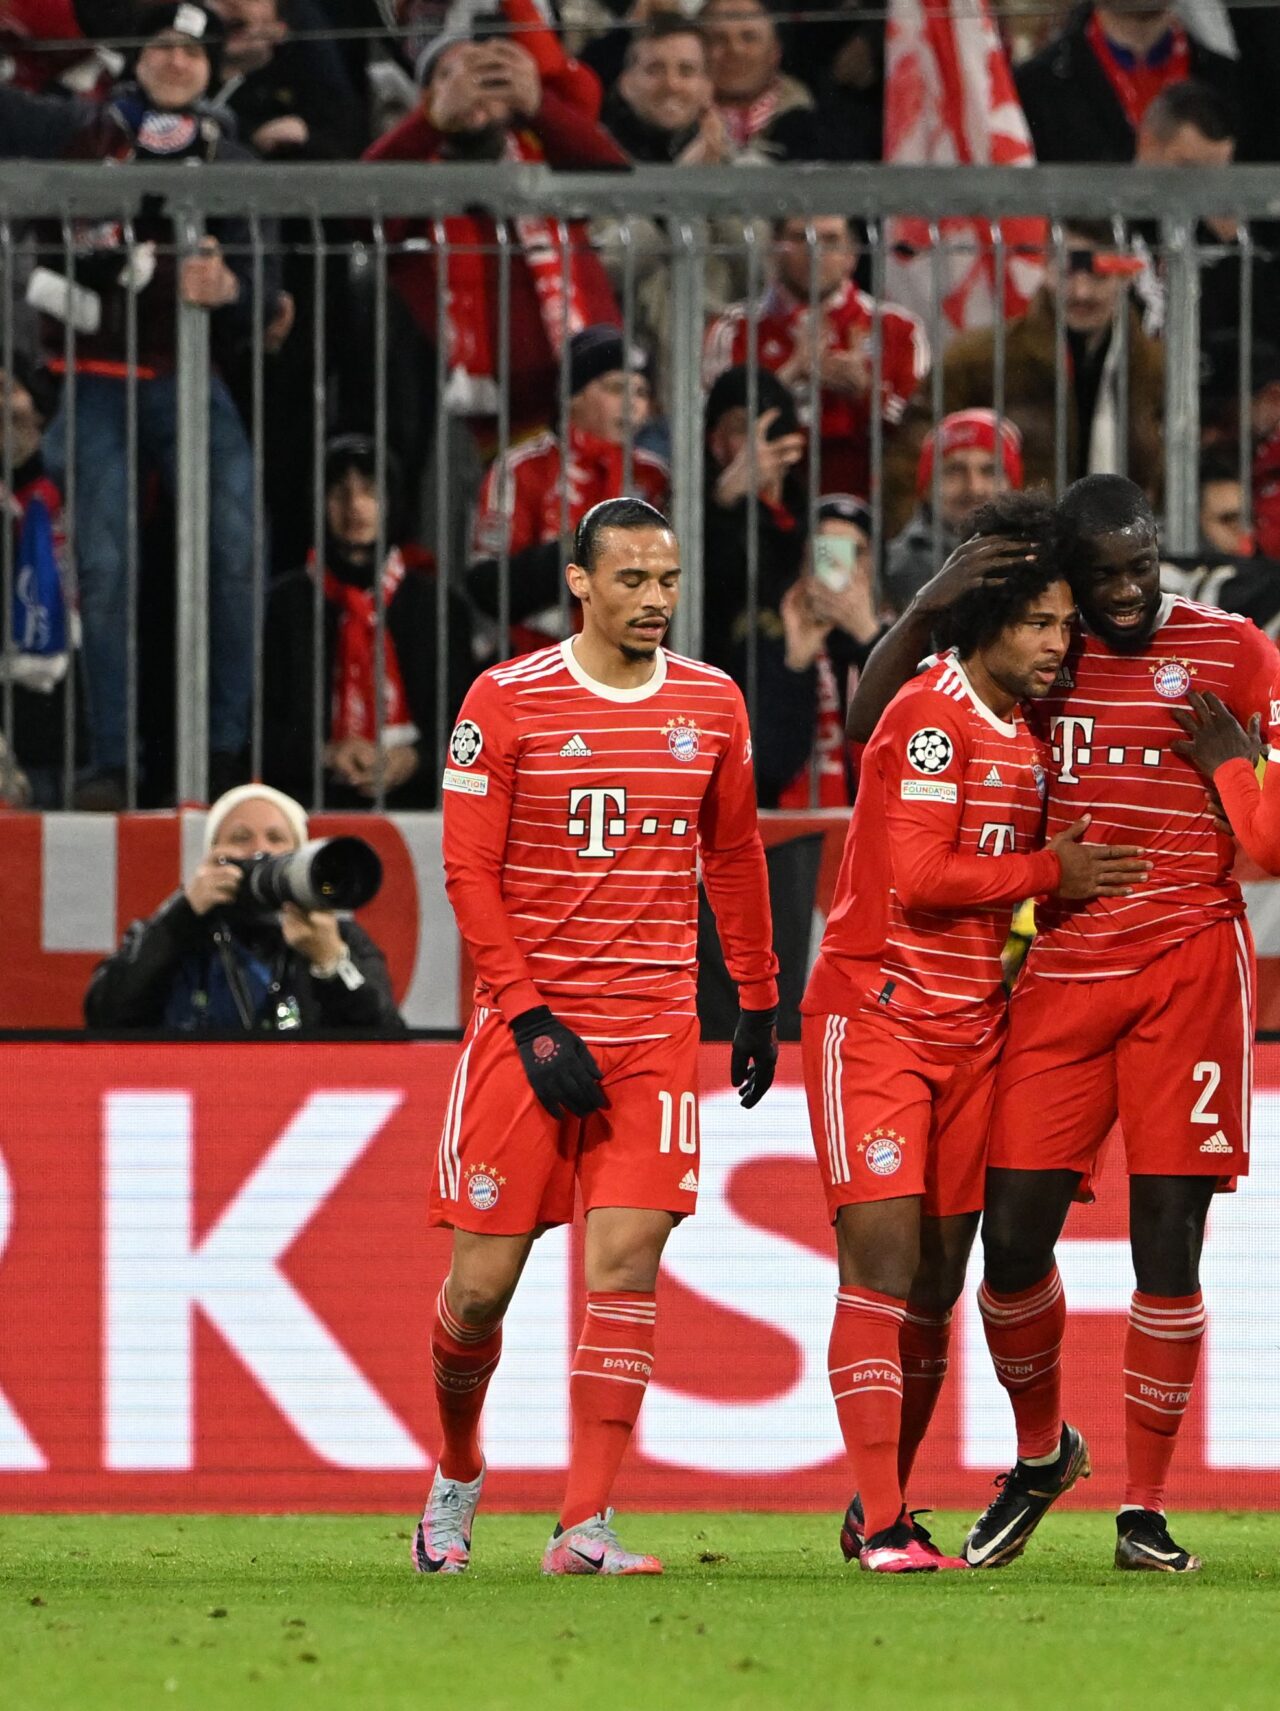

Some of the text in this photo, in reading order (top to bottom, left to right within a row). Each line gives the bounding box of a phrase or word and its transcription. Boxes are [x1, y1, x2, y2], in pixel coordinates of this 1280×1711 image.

[559, 749, 592, 757] adidas
[903, 785, 956, 797] FOUNDATION
[1190, 1061, 1221, 1125] 2
[658, 1090, 697, 1155] 10
[1199, 1145, 1234, 1154] adidas
